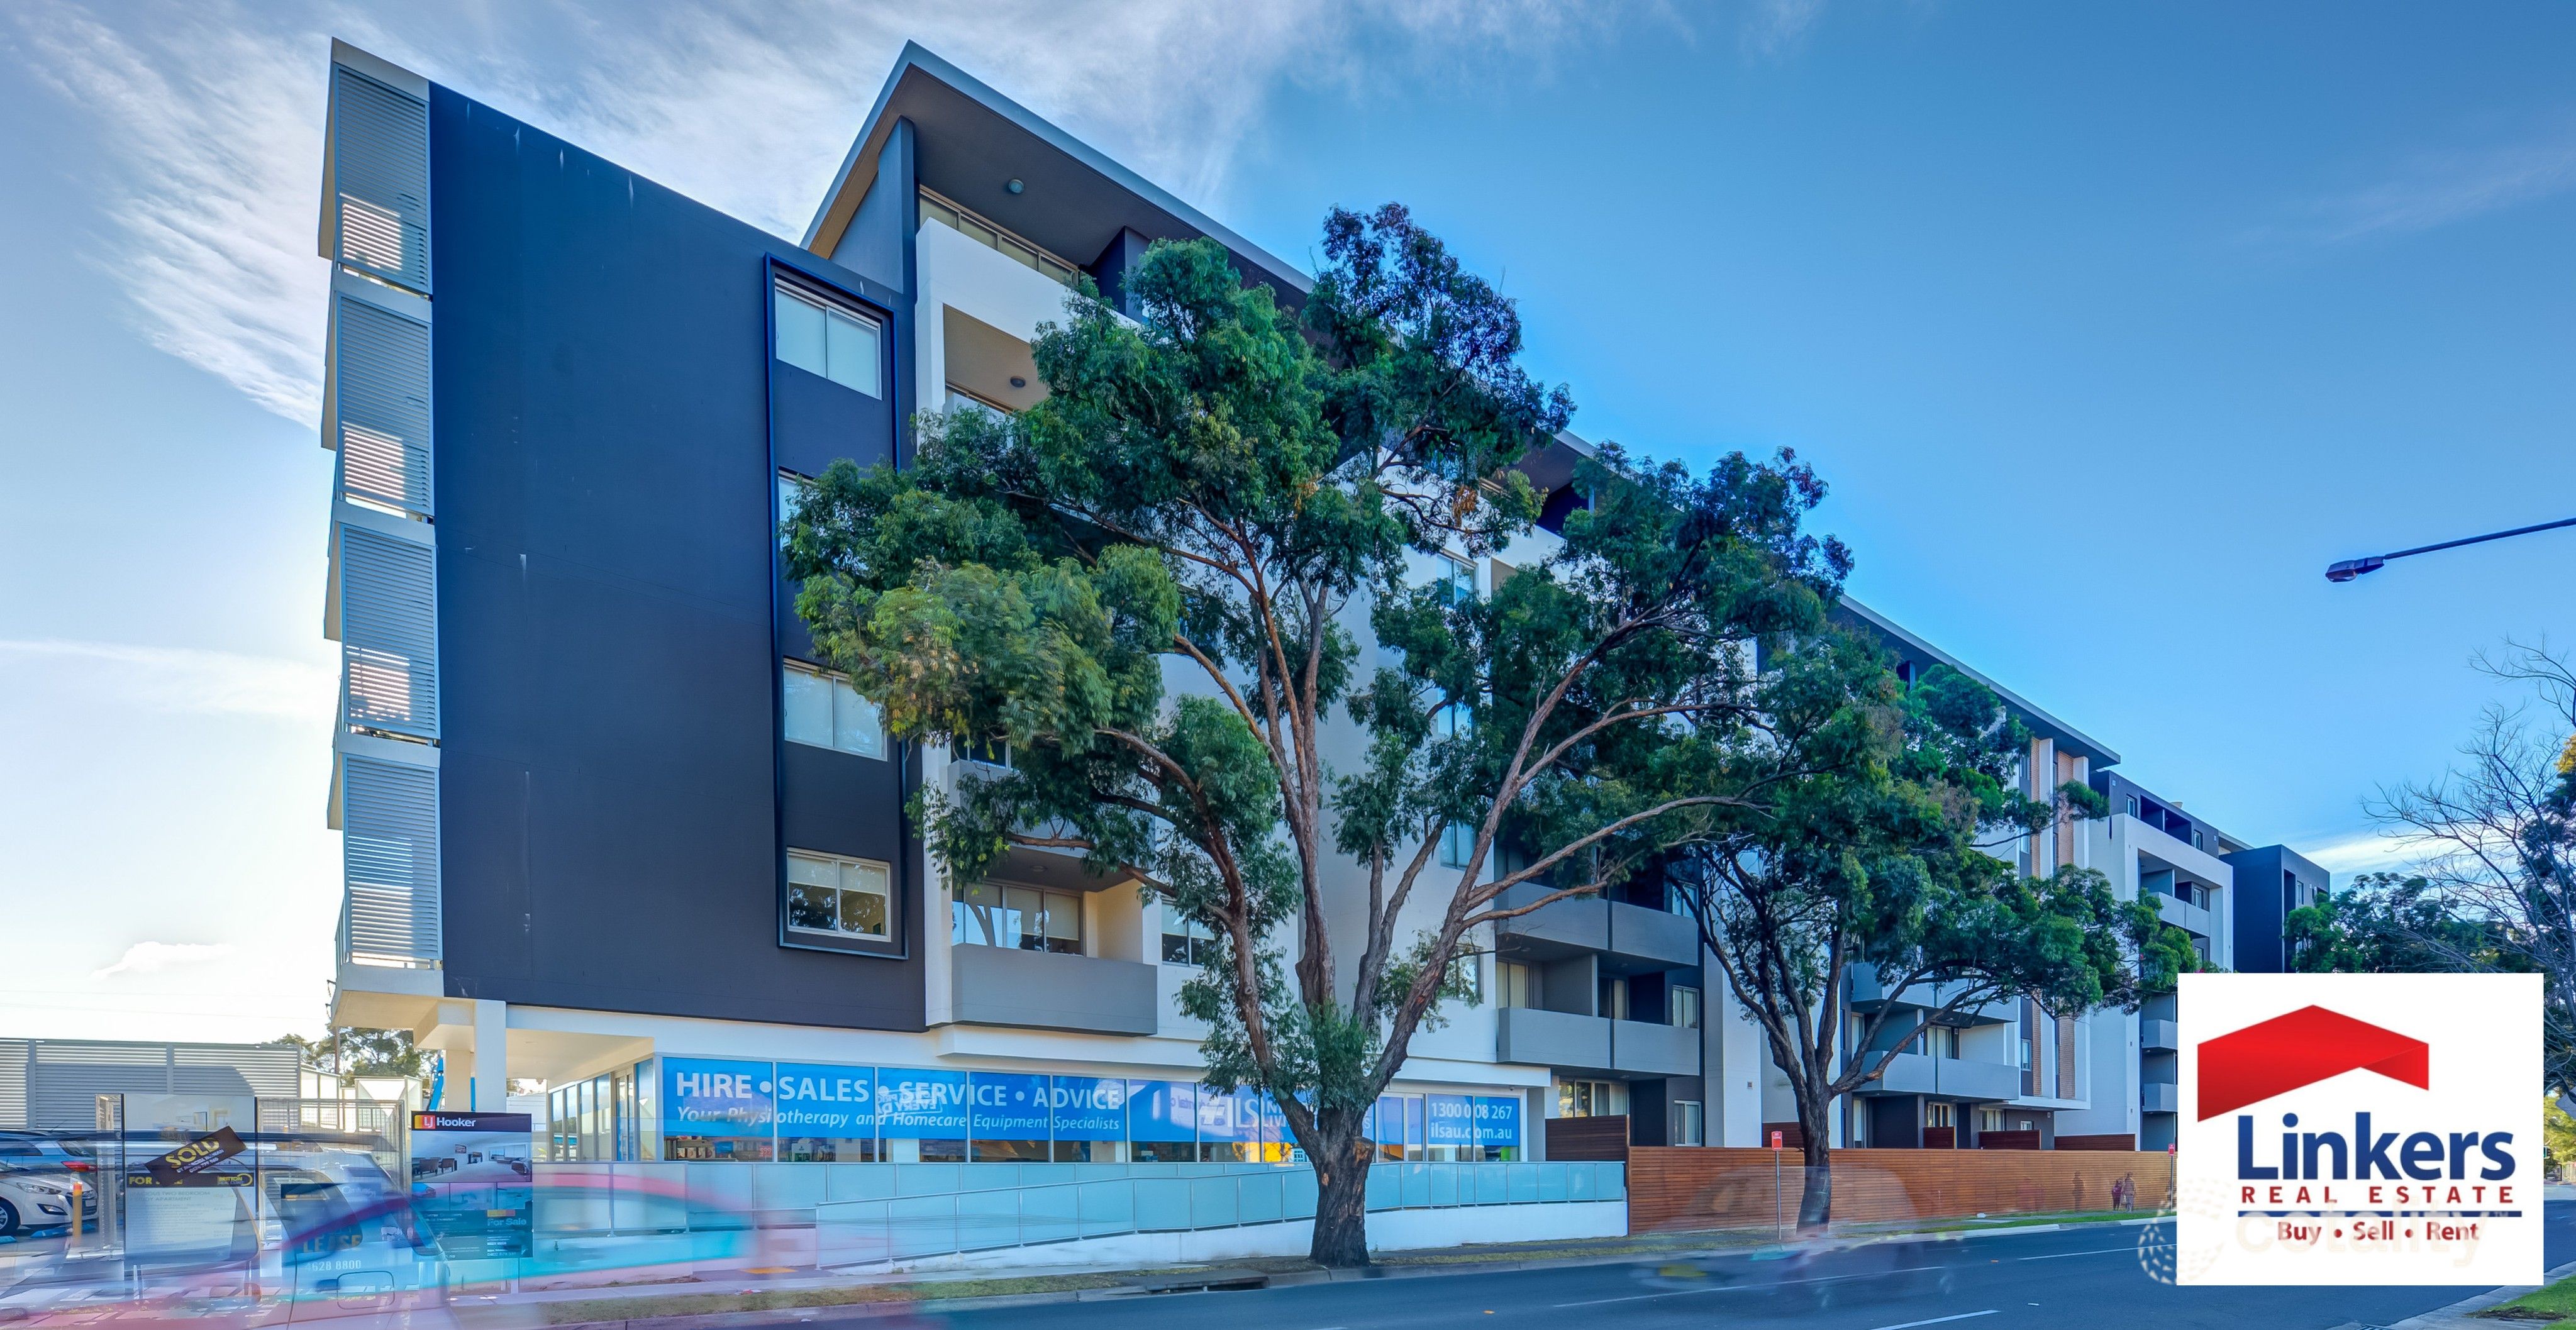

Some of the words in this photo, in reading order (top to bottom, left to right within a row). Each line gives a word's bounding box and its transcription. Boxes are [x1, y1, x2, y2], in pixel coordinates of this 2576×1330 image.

[676, 1072, 753, 1099] HIRE
[779, 1076, 870, 1102] SALES
[898, 1081, 1007, 1106] SERVICE
[1033, 1087, 1119, 1110] ADVICE
[677, 1106, 722, 1122] Your
[726, 1106, 849, 1128] Physiotherapy
[855, 1112, 886, 1125] and
[892, 1112, 967, 1126] Homecare
[974, 1114, 1048, 1131] Equipment
[1053, 1116, 1119, 1131] Specialists
[1431, 1102, 1462, 1118] 1300
[1463, 1104, 1489, 1119] 008
[1492, 1105, 1513, 1120] 267
[436, 1117, 476, 1127] Hooker
[1431, 1122, 1513, 1139] ilsau.com.au
[165, 1138, 219, 1168] SOLD
[129, 1177, 153, 1185] FOR
[506, 1217, 527, 1226] Sale
